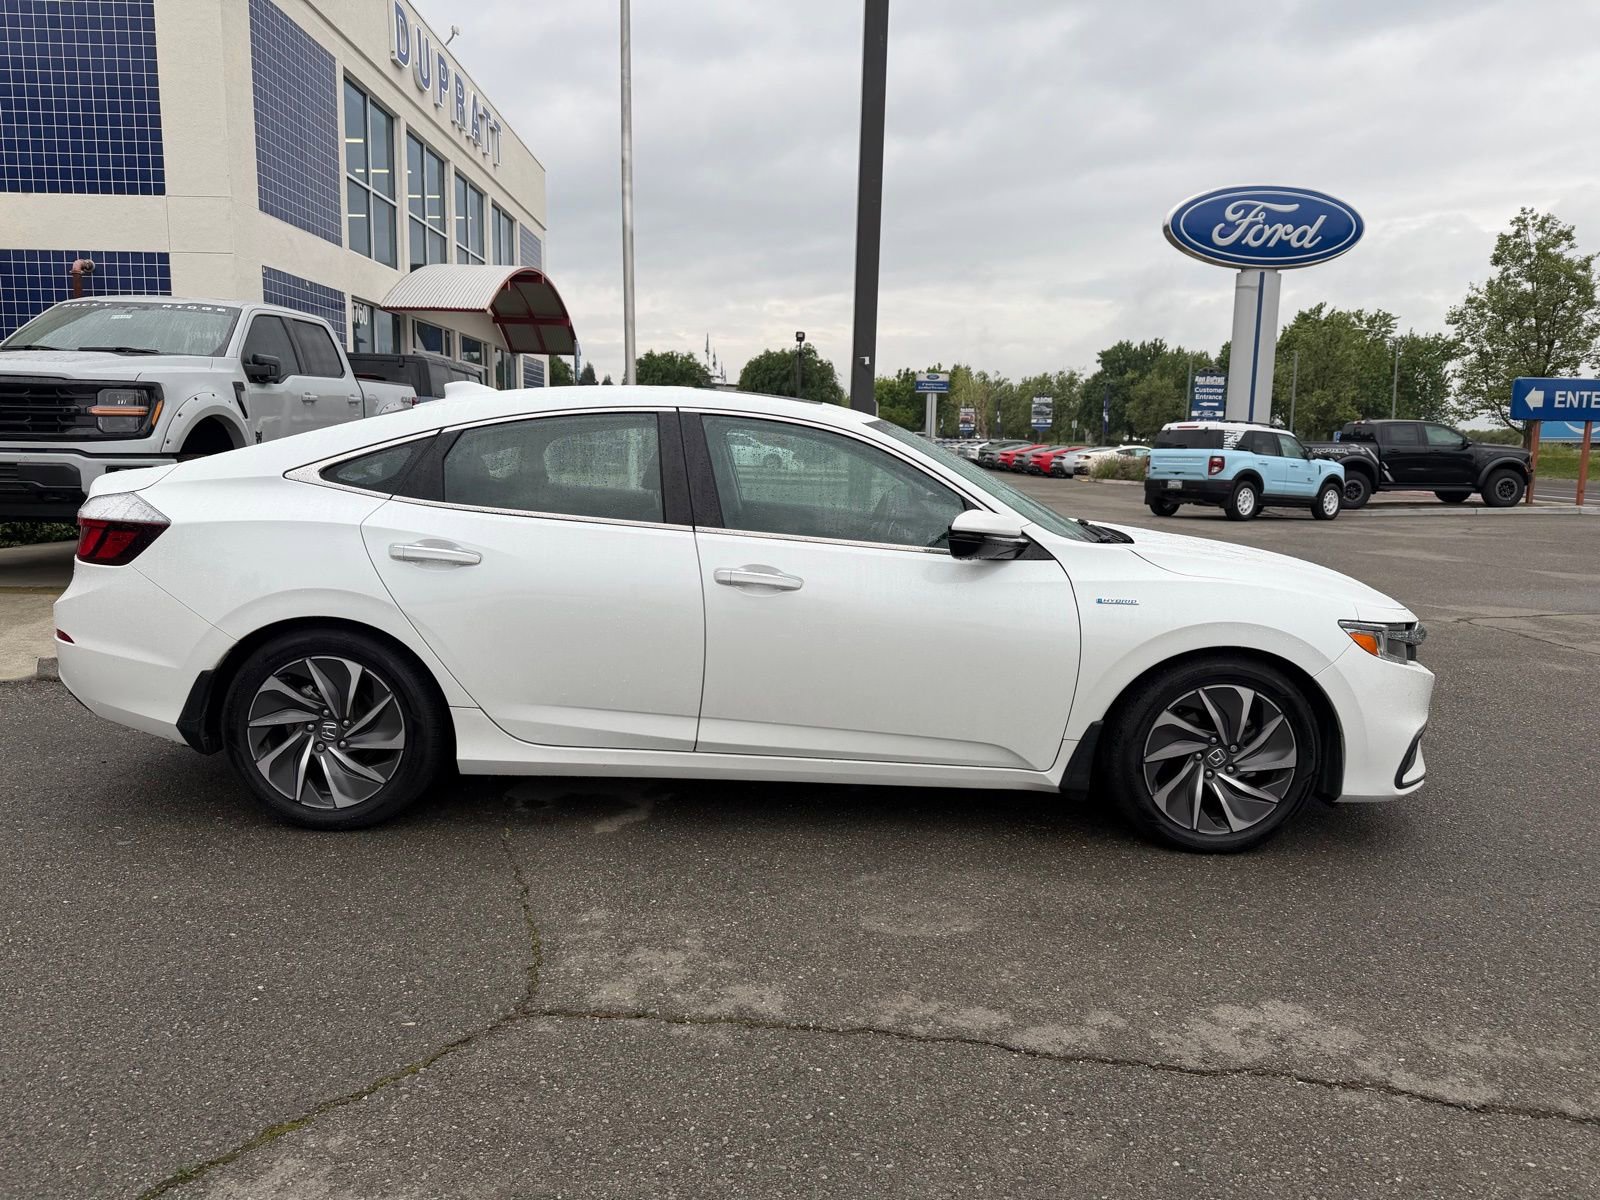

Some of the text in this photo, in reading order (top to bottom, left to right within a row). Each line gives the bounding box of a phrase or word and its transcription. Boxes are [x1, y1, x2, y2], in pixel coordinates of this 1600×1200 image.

[388, 0, 502, 167] DUPRATT
[1211, 199, 1328, 249] Ford
[162, 304, 227, 312] RIDGE
[1554, 390, 1600, 409] ENTE
